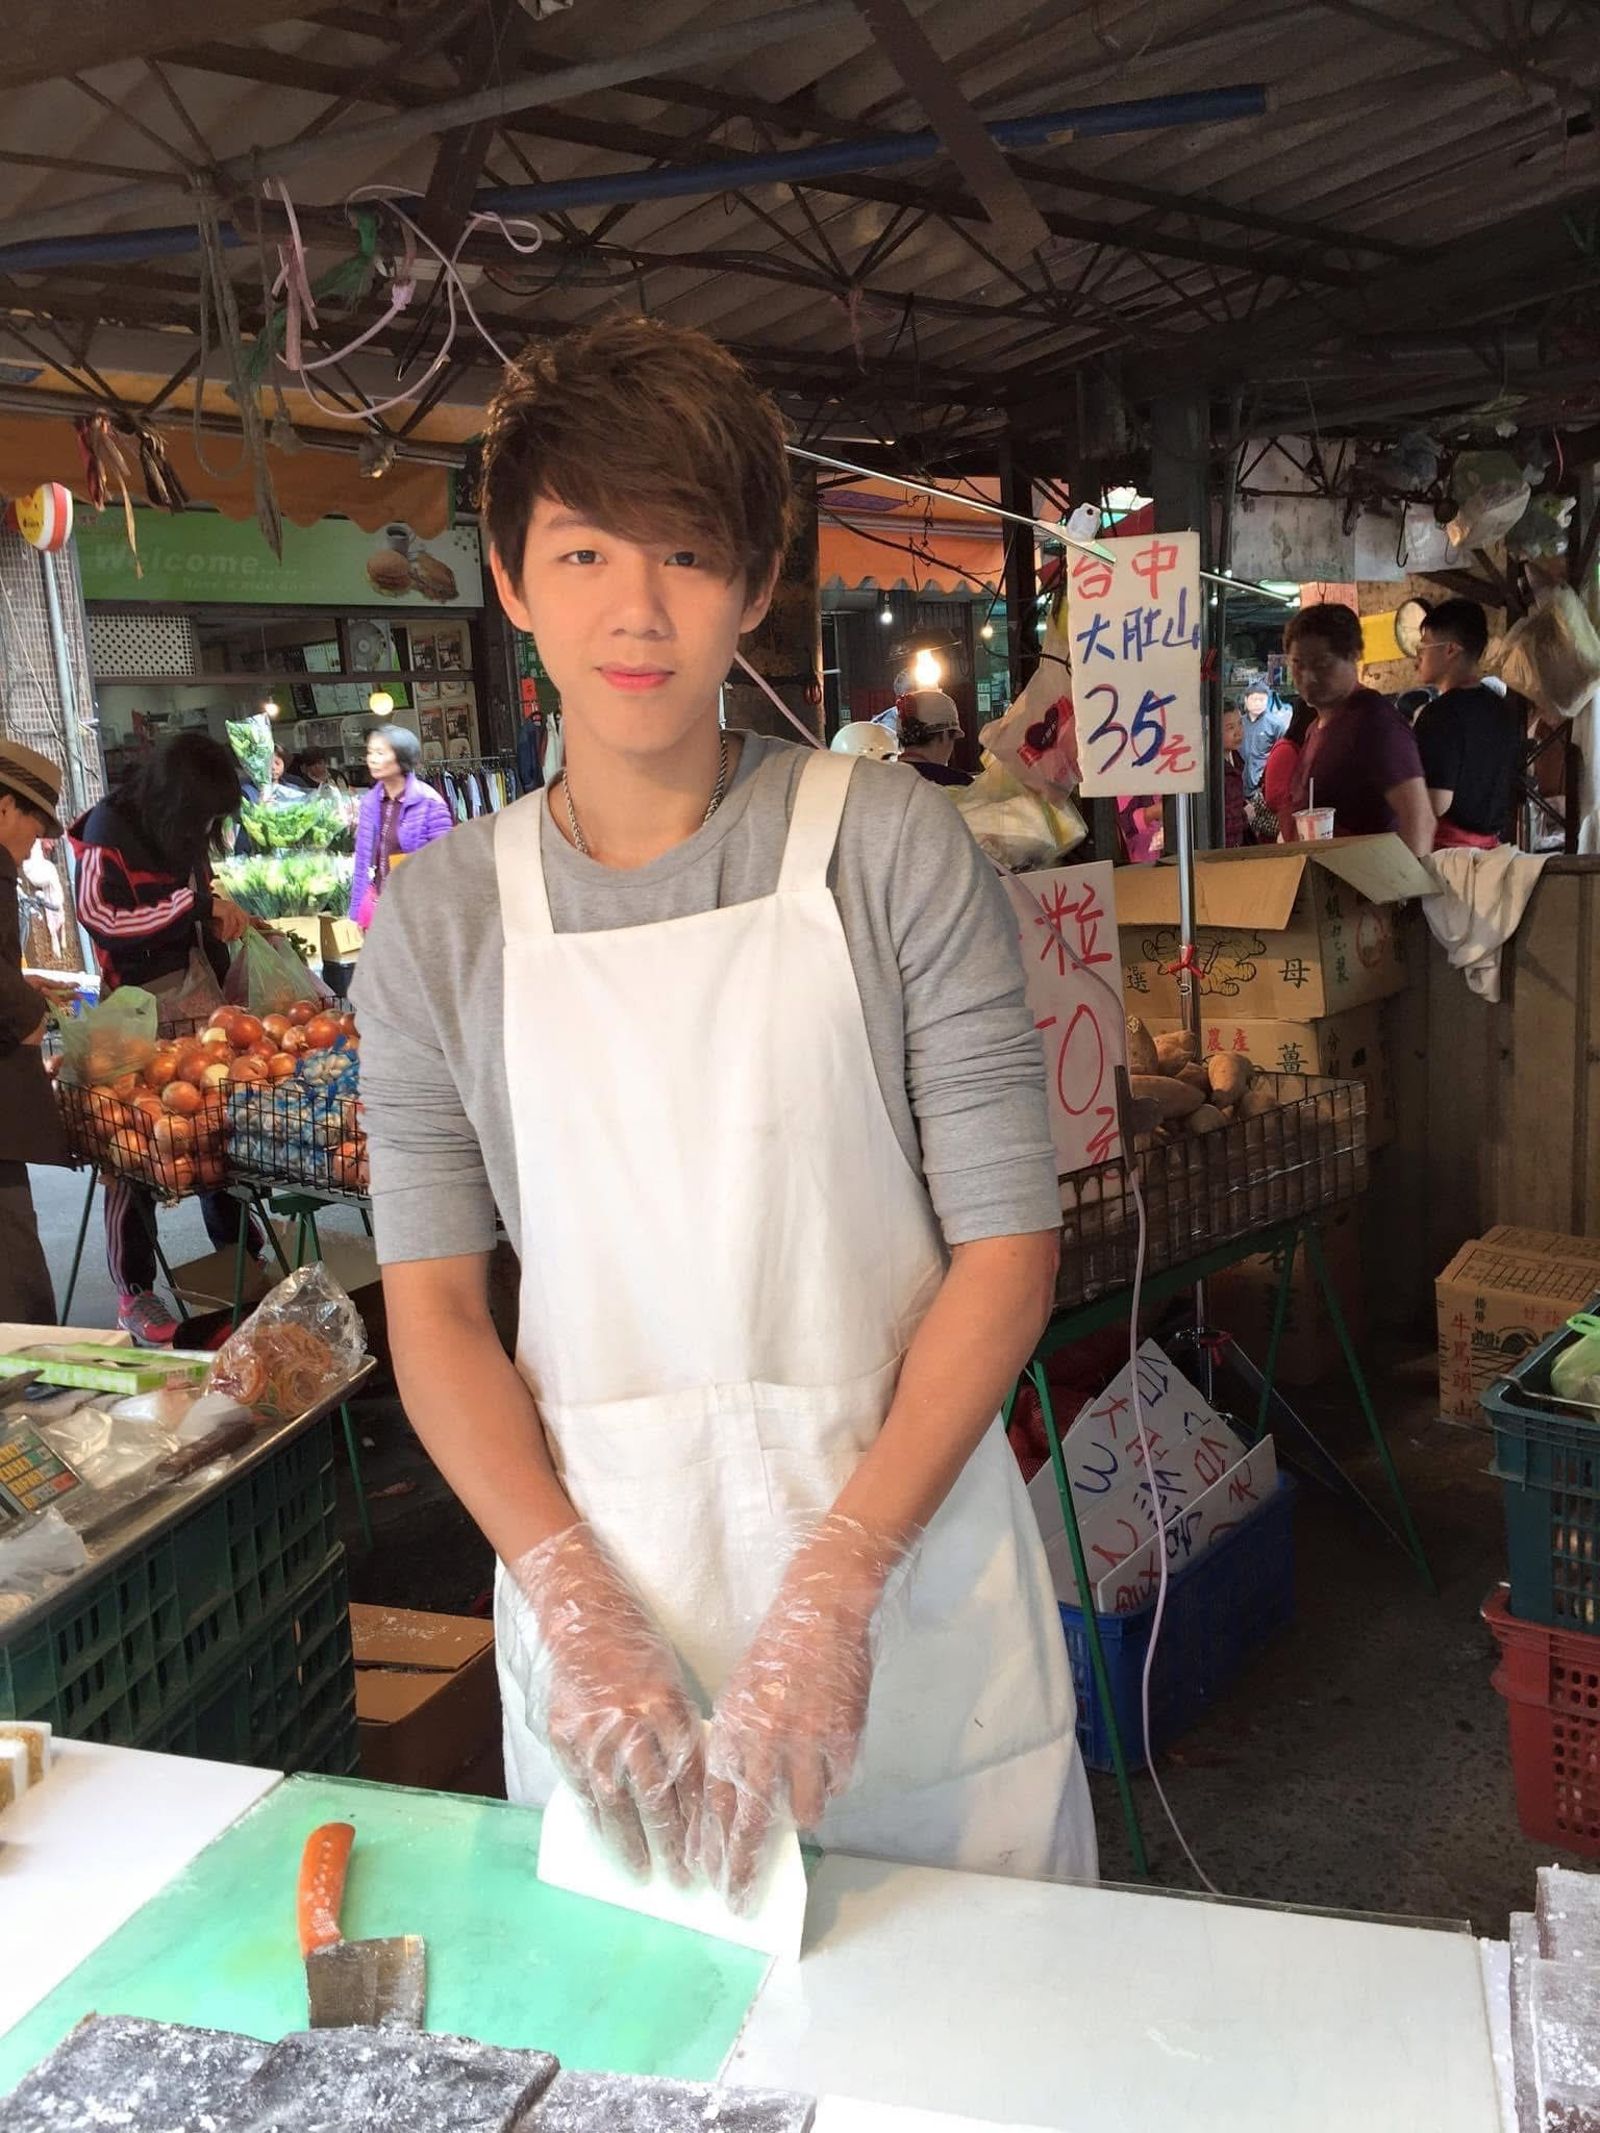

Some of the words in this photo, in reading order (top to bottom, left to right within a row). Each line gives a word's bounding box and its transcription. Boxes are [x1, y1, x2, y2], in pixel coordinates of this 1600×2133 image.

[1073, 540, 1178, 599] 台中
[1077, 587, 1200, 664] 大肚山
[1035, 882, 1112, 975] 粒
[1279, 958, 1311, 989] 母
[1207, 1026, 1249, 1052] 農產
